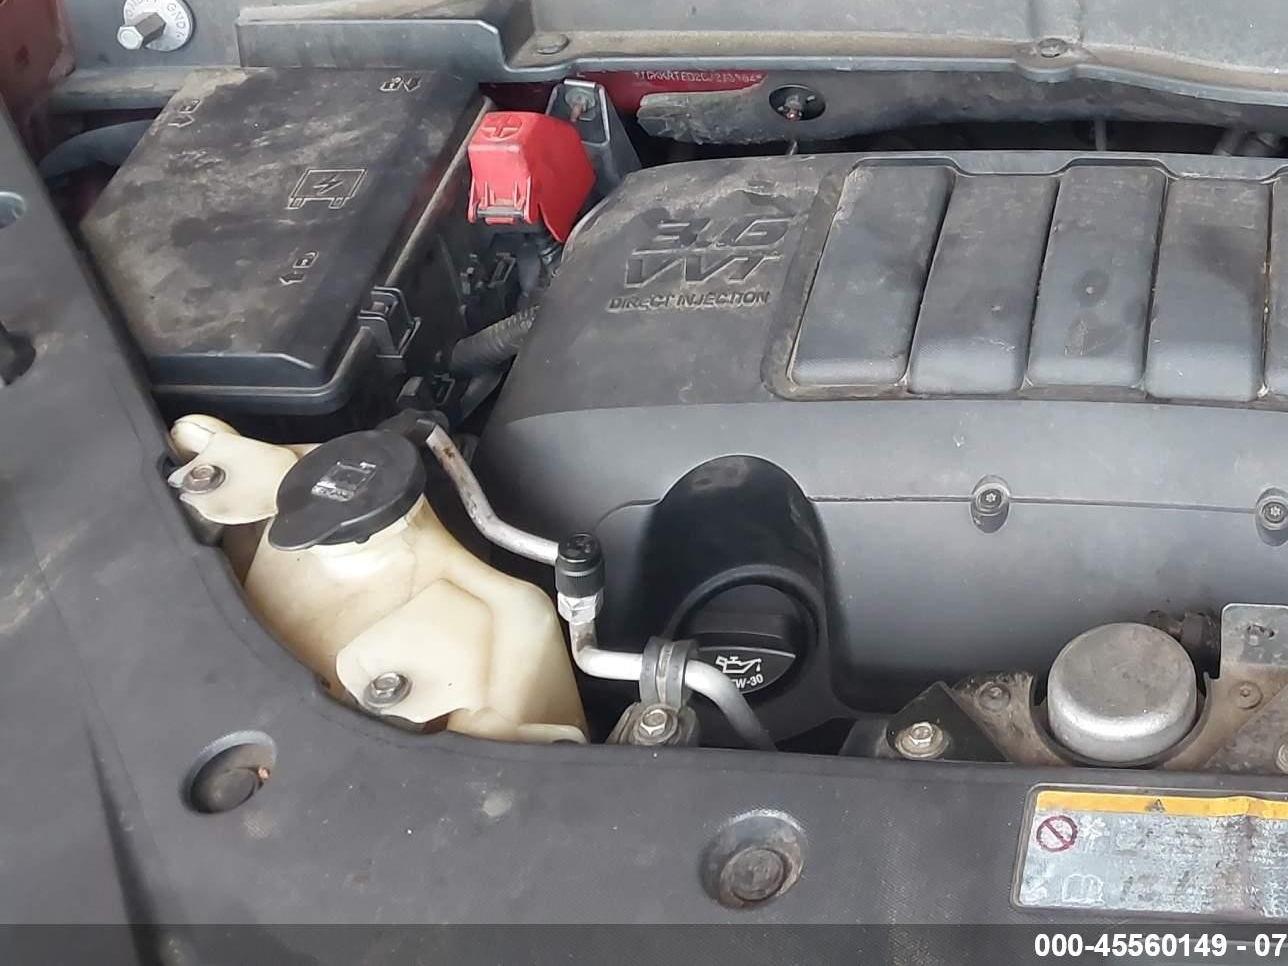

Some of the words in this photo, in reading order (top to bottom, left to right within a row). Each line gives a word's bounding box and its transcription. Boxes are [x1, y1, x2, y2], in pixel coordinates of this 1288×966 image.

[624, 254, 784, 289] VVT
[608, 296, 672, 313] DIRECT
[676, 291, 770, 309] INJECTION
[730, 674, 764, 689] W-30
